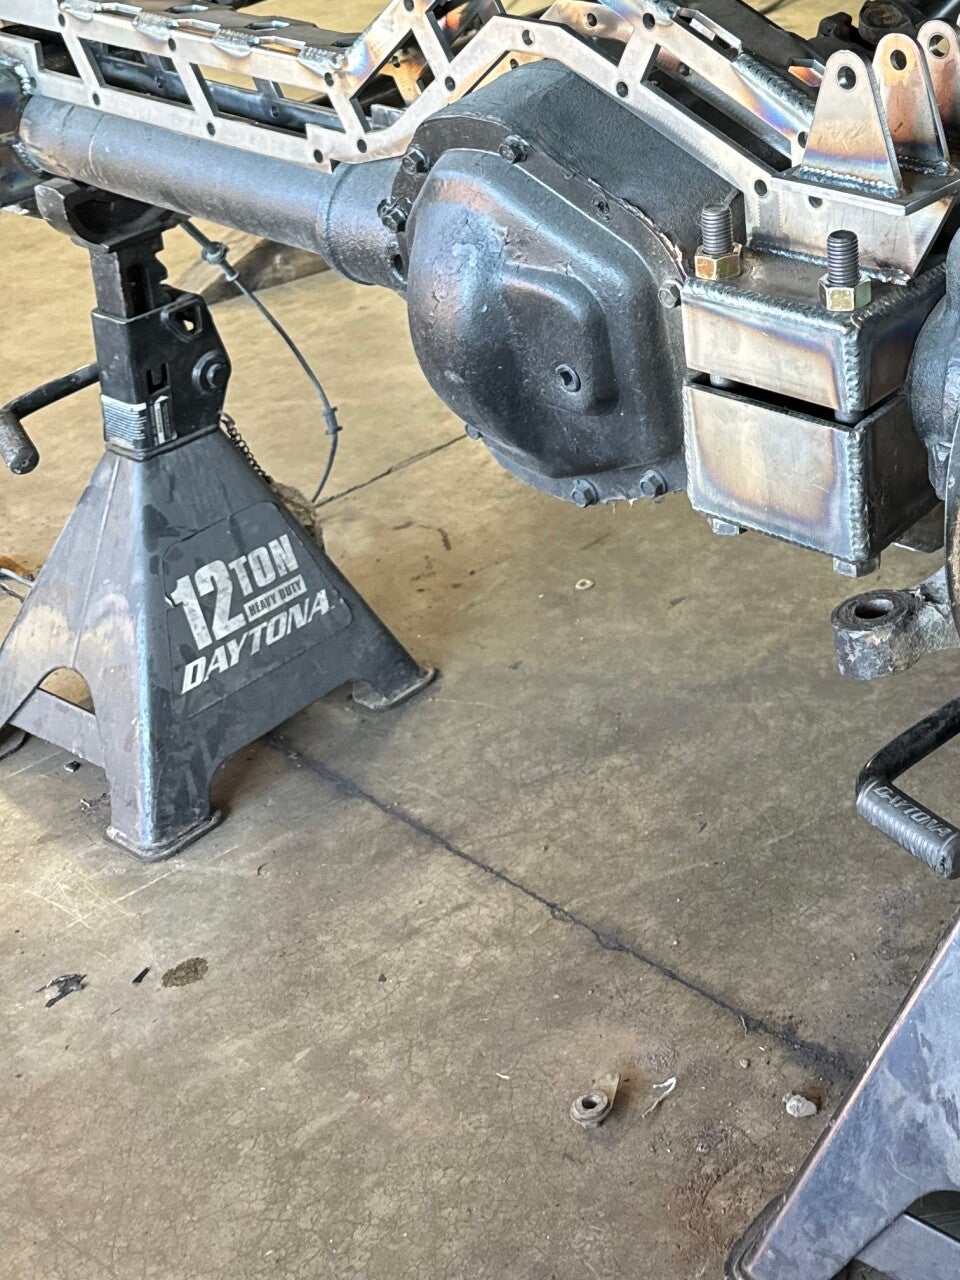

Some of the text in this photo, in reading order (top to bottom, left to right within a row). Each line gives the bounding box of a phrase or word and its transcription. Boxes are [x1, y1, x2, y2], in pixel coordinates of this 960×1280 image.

[170, 533, 299, 651] 12 TON
[181, 589, 330, 695] DAYTONA
[248, 579, 301, 617] HEAVY DUTY
